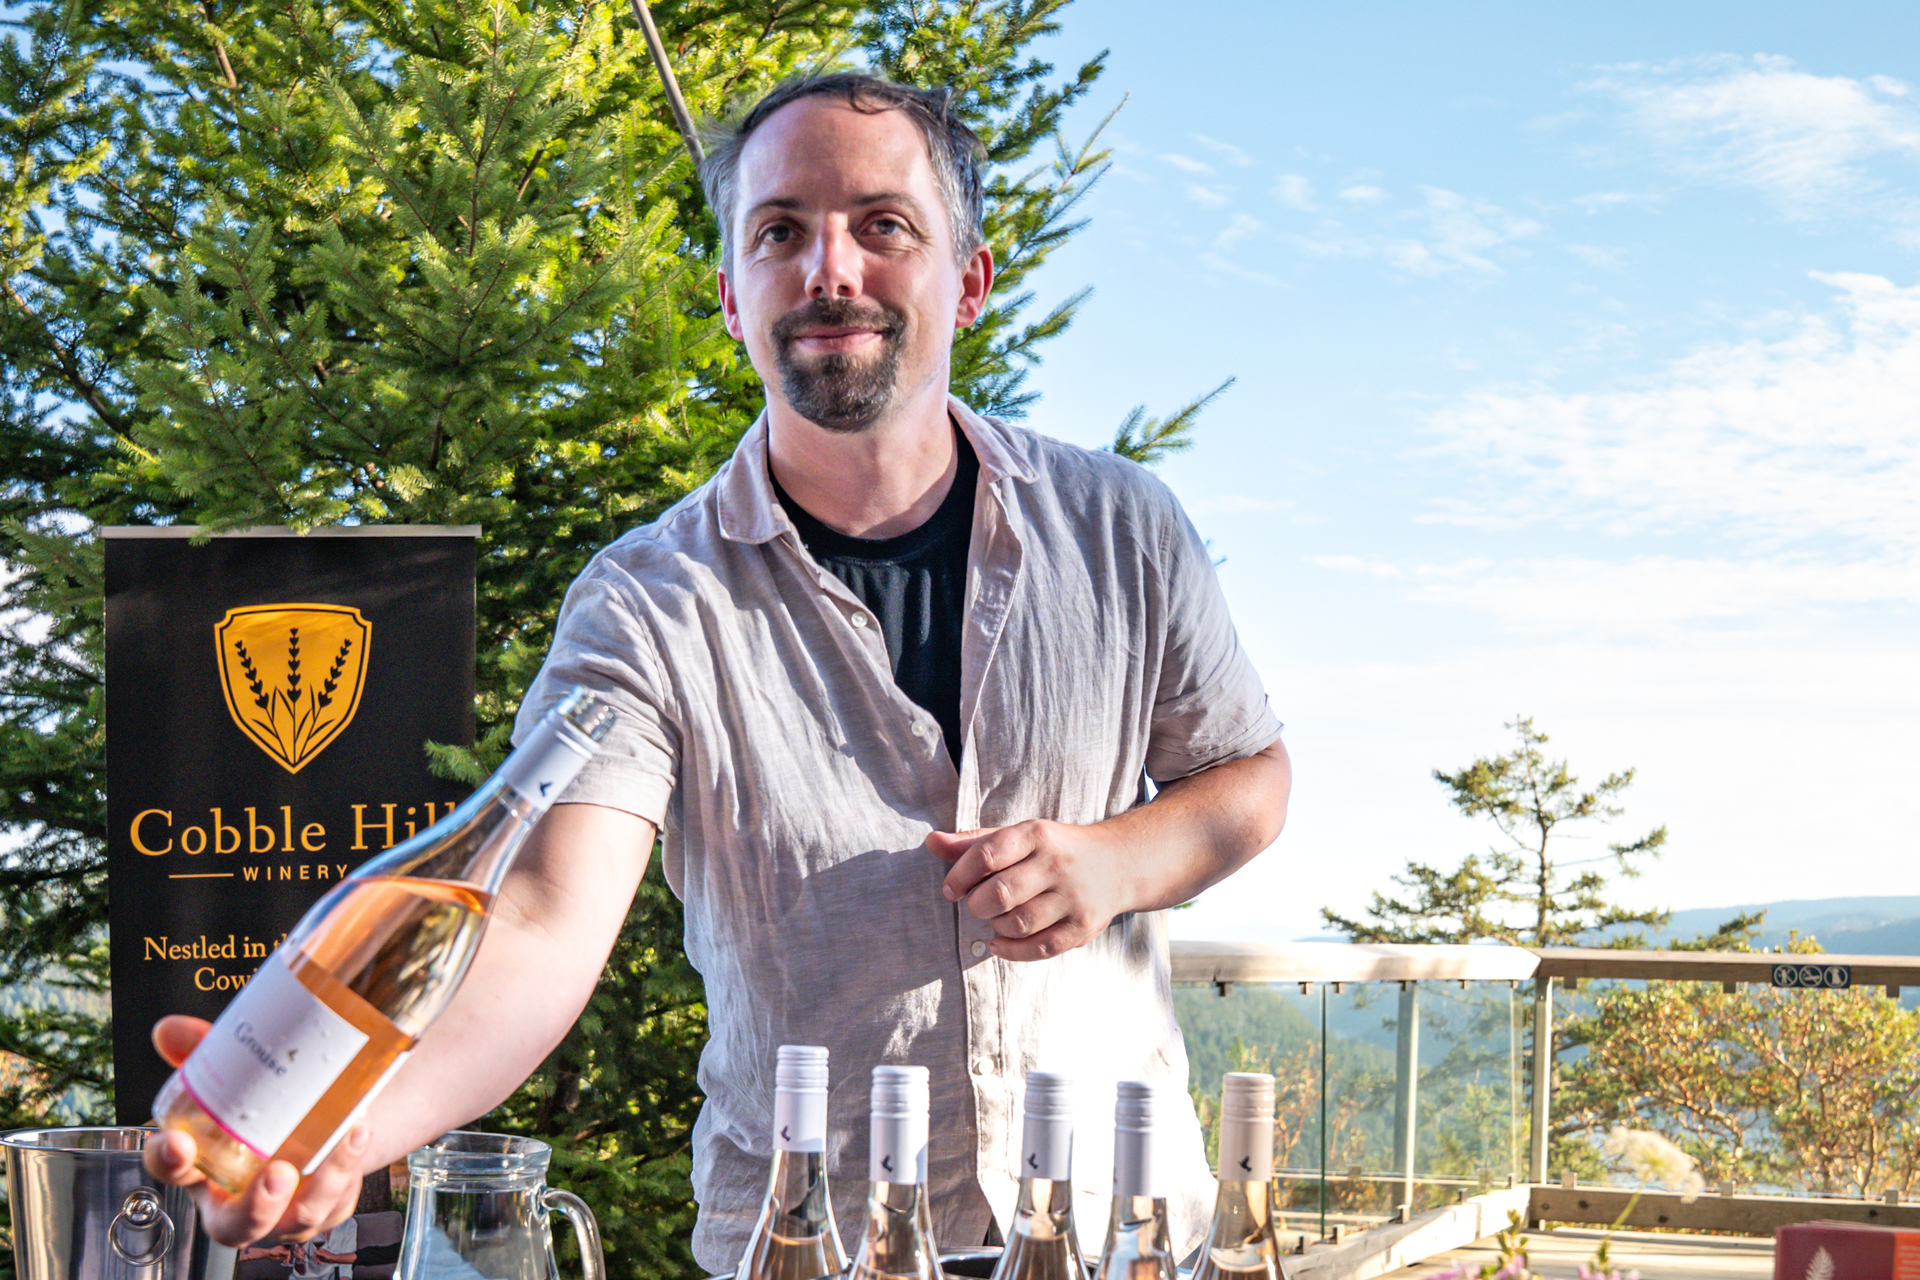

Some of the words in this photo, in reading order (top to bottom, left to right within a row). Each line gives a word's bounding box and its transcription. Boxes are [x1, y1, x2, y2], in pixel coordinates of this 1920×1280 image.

[129, 805, 327, 857] Cobble
[242, 864, 348, 881] WINERY
[143, 934, 237, 960] Nestled
[243, 936, 267, 958] in
[194, 966, 258, 991] Cow
